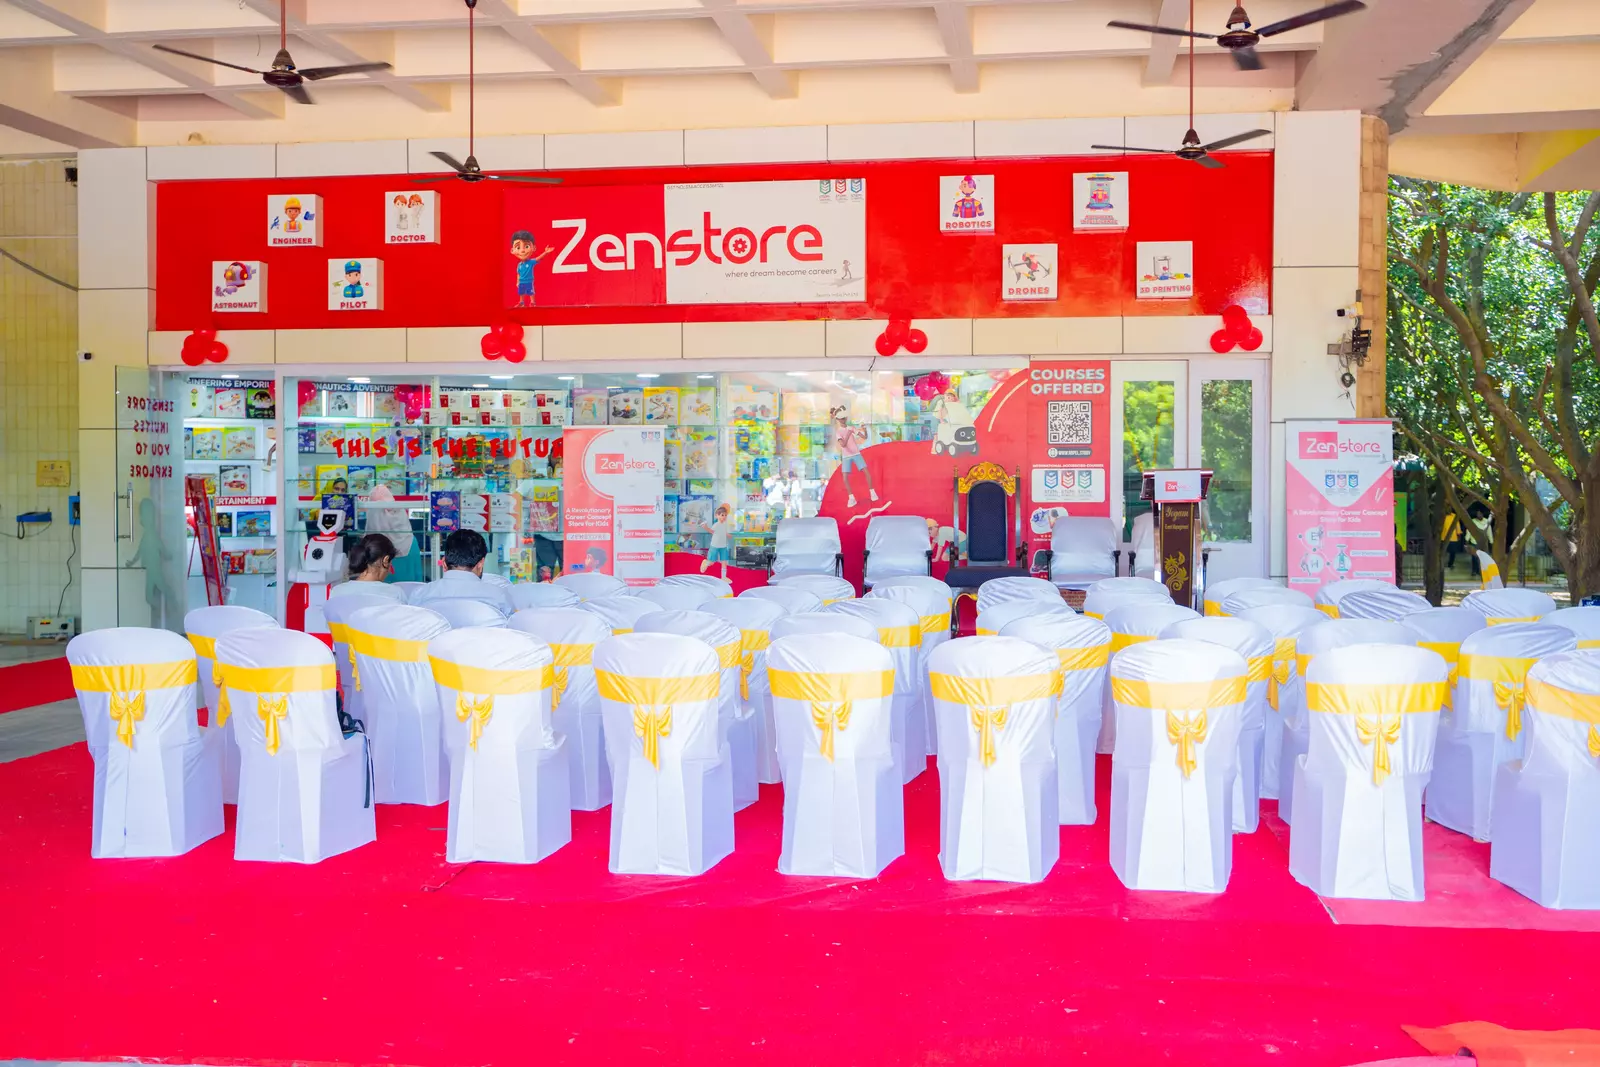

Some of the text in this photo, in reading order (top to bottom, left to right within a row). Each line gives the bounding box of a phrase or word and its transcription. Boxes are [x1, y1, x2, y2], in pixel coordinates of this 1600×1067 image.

[945, 221, 992, 229] ROBOTICS
[272, 237, 313, 245] ENGINEER
[551, 211, 824, 274] Zenstore
[725, 267, 837, 278] where dream become careers
[1008, 287, 1050, 295] DRONES
[1140, 284, 1191, 294] 3D PRINTING
[1030, 368, 1105, 380] COURSES
[1030, 383, 1105, 395] OFFERED
[332, 437, 388, 459] THIS
[398, 437, 422, 459] IS
[432, 437, 479, 459] THE
[1306, 437, 1381, 454] Zenstore
[600, 457, 656, 470] Zenstore
[1362, 509, 1388, 517] Concept
